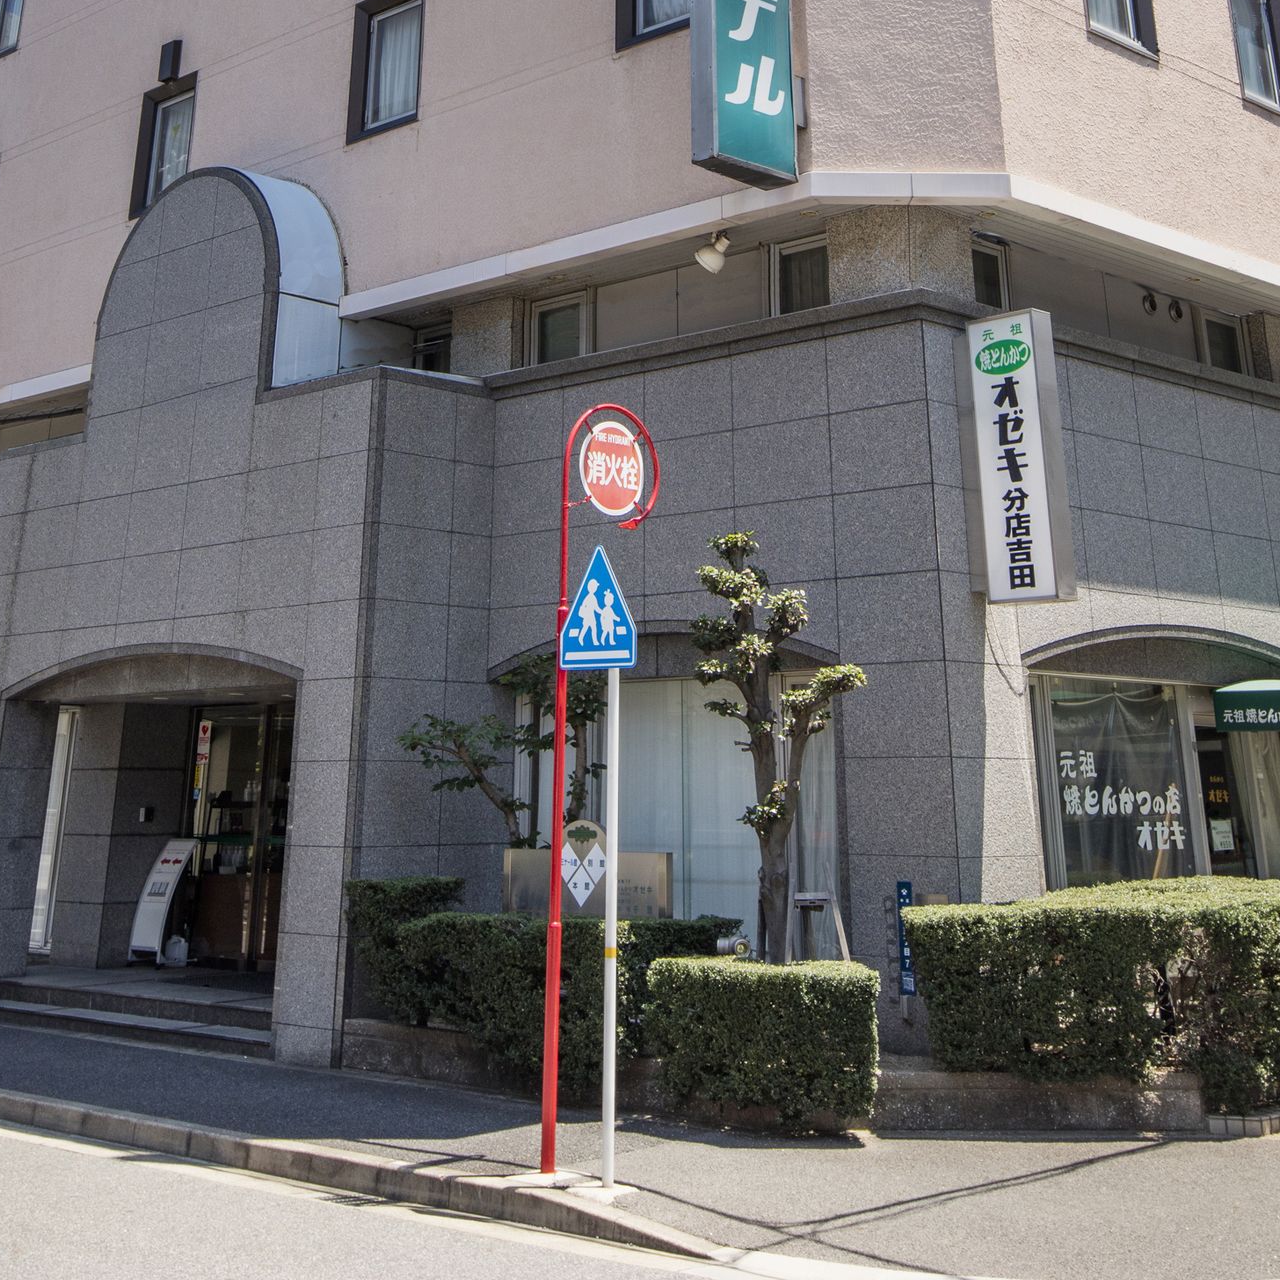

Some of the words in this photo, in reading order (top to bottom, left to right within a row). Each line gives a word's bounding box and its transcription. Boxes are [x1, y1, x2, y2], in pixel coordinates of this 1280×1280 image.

[982, 323, 1023, 341] 元祖
[979, 342, 1029, 371] 焼とんかつ
[595, 432, 607, 442] FIRE
[587, 451, 639, 491] 消火栓
[1059, 749, 1098, 779] 元祖
[1063, 785, 1181, 816] 焼とんかつの店
[1136, 821, 1186, 851] オゼキ
